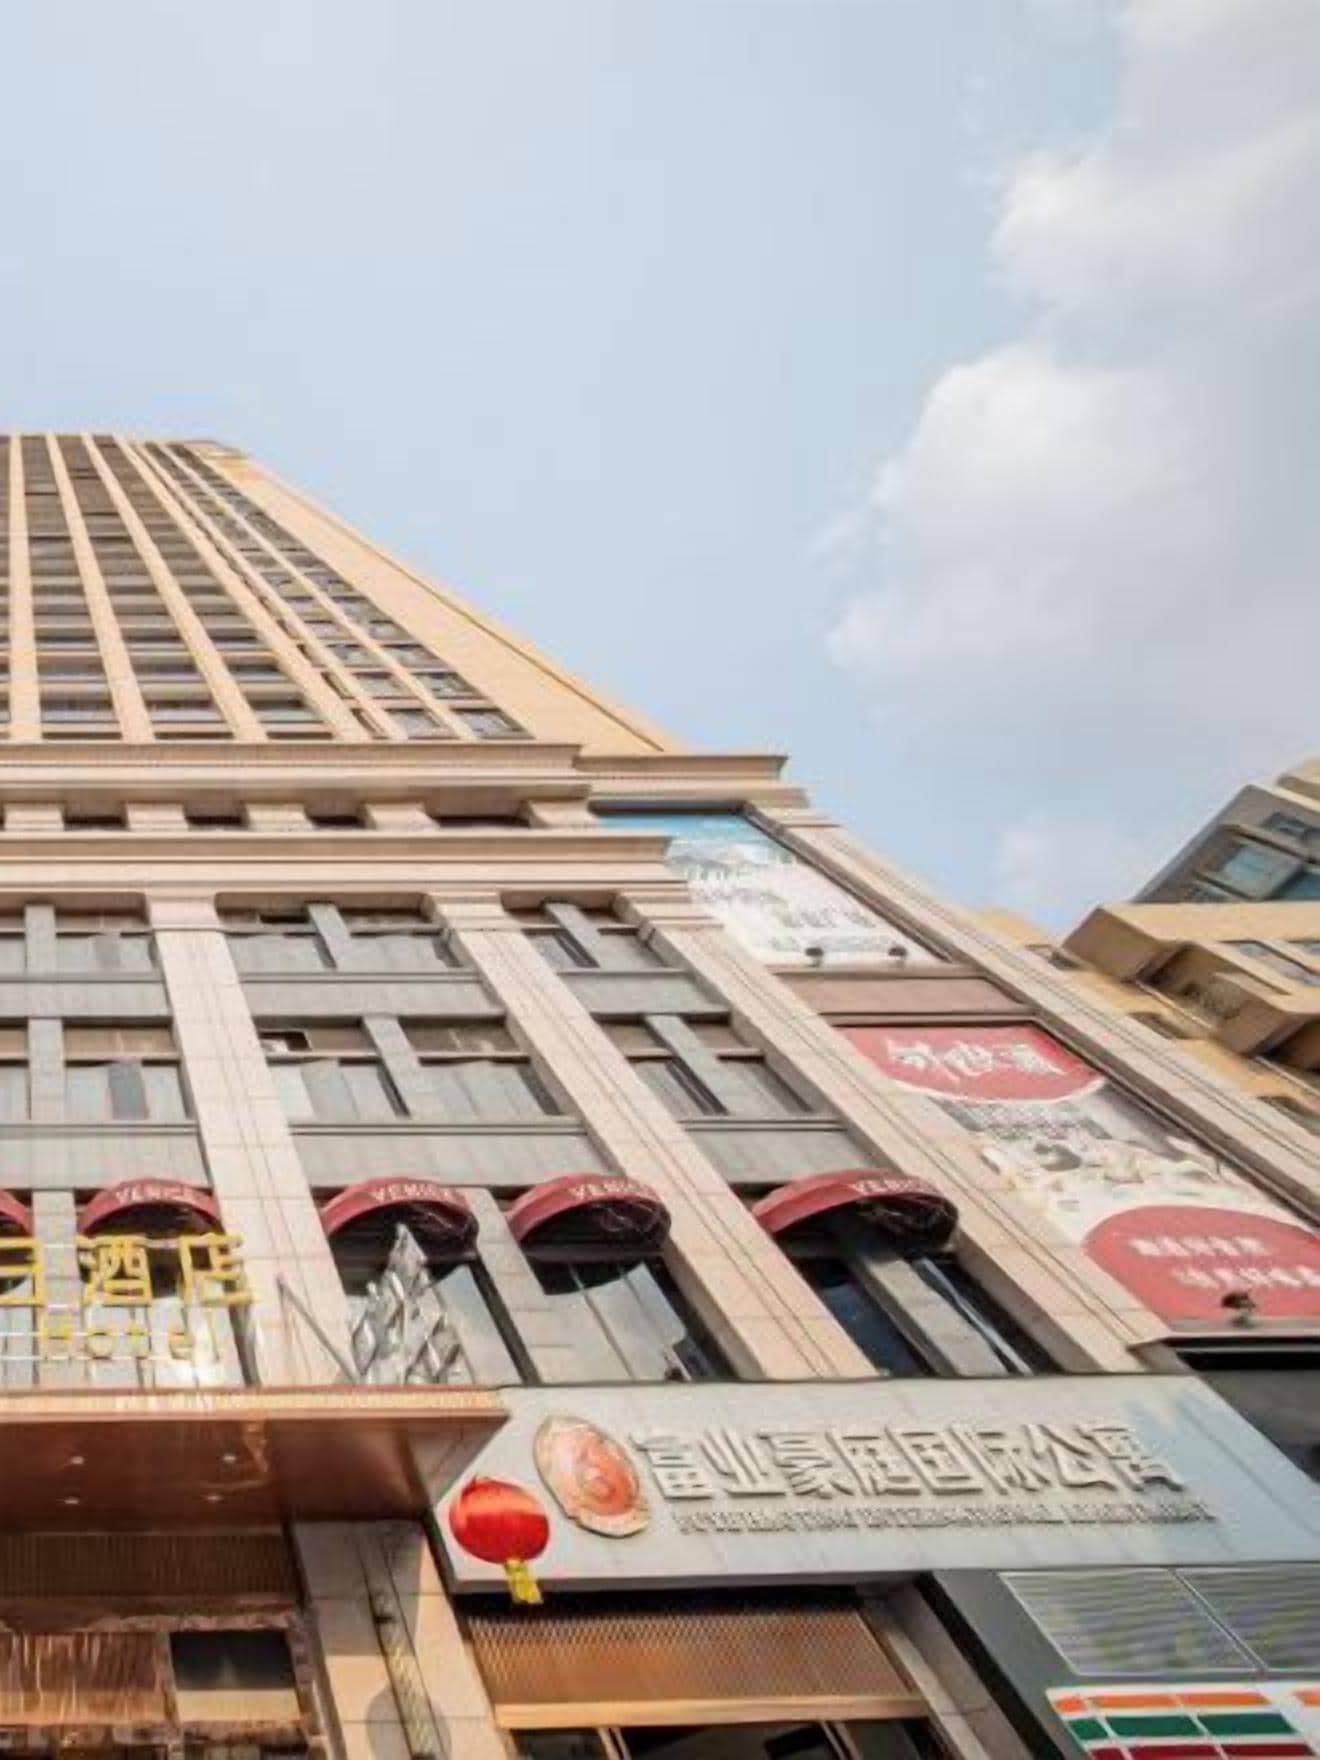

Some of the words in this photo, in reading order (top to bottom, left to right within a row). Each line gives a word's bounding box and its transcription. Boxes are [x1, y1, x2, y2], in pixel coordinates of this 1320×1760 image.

[40, 1309, 221, 1363] Hotel
[628, 1424, 1185, 1502] 富业豪庭国际公寓
